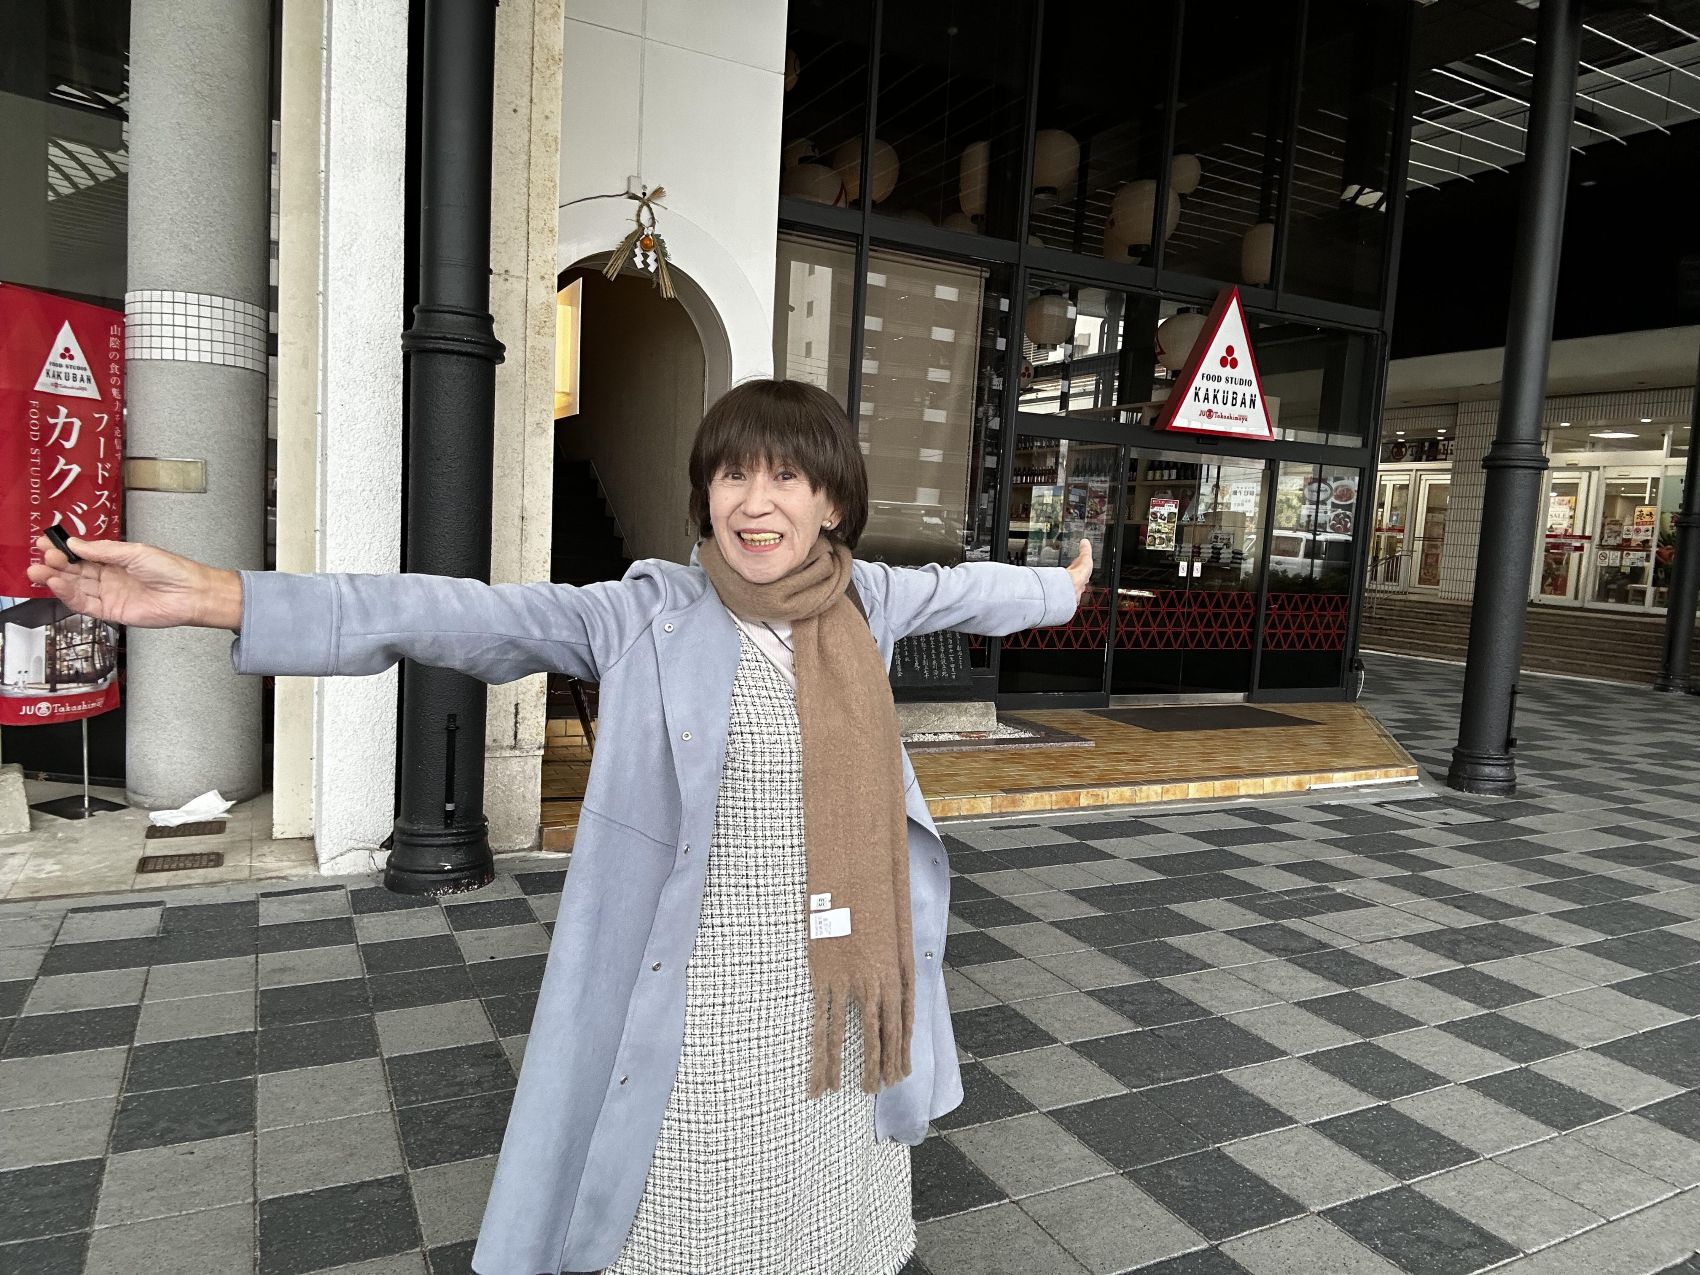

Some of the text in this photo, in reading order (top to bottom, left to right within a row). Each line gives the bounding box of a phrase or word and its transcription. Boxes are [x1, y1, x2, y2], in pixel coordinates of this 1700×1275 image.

[46, 368, 92, 384] KAKUBAN
[1201, 372, 1253, 387] FOOD STUDIO
[1194, 386, 1256, 409] KAKUBAN
[28, 400, 40, 442] FOOD
[30, 447, 42, 505] STUDIO
[20, 706, 34, 715] JU
